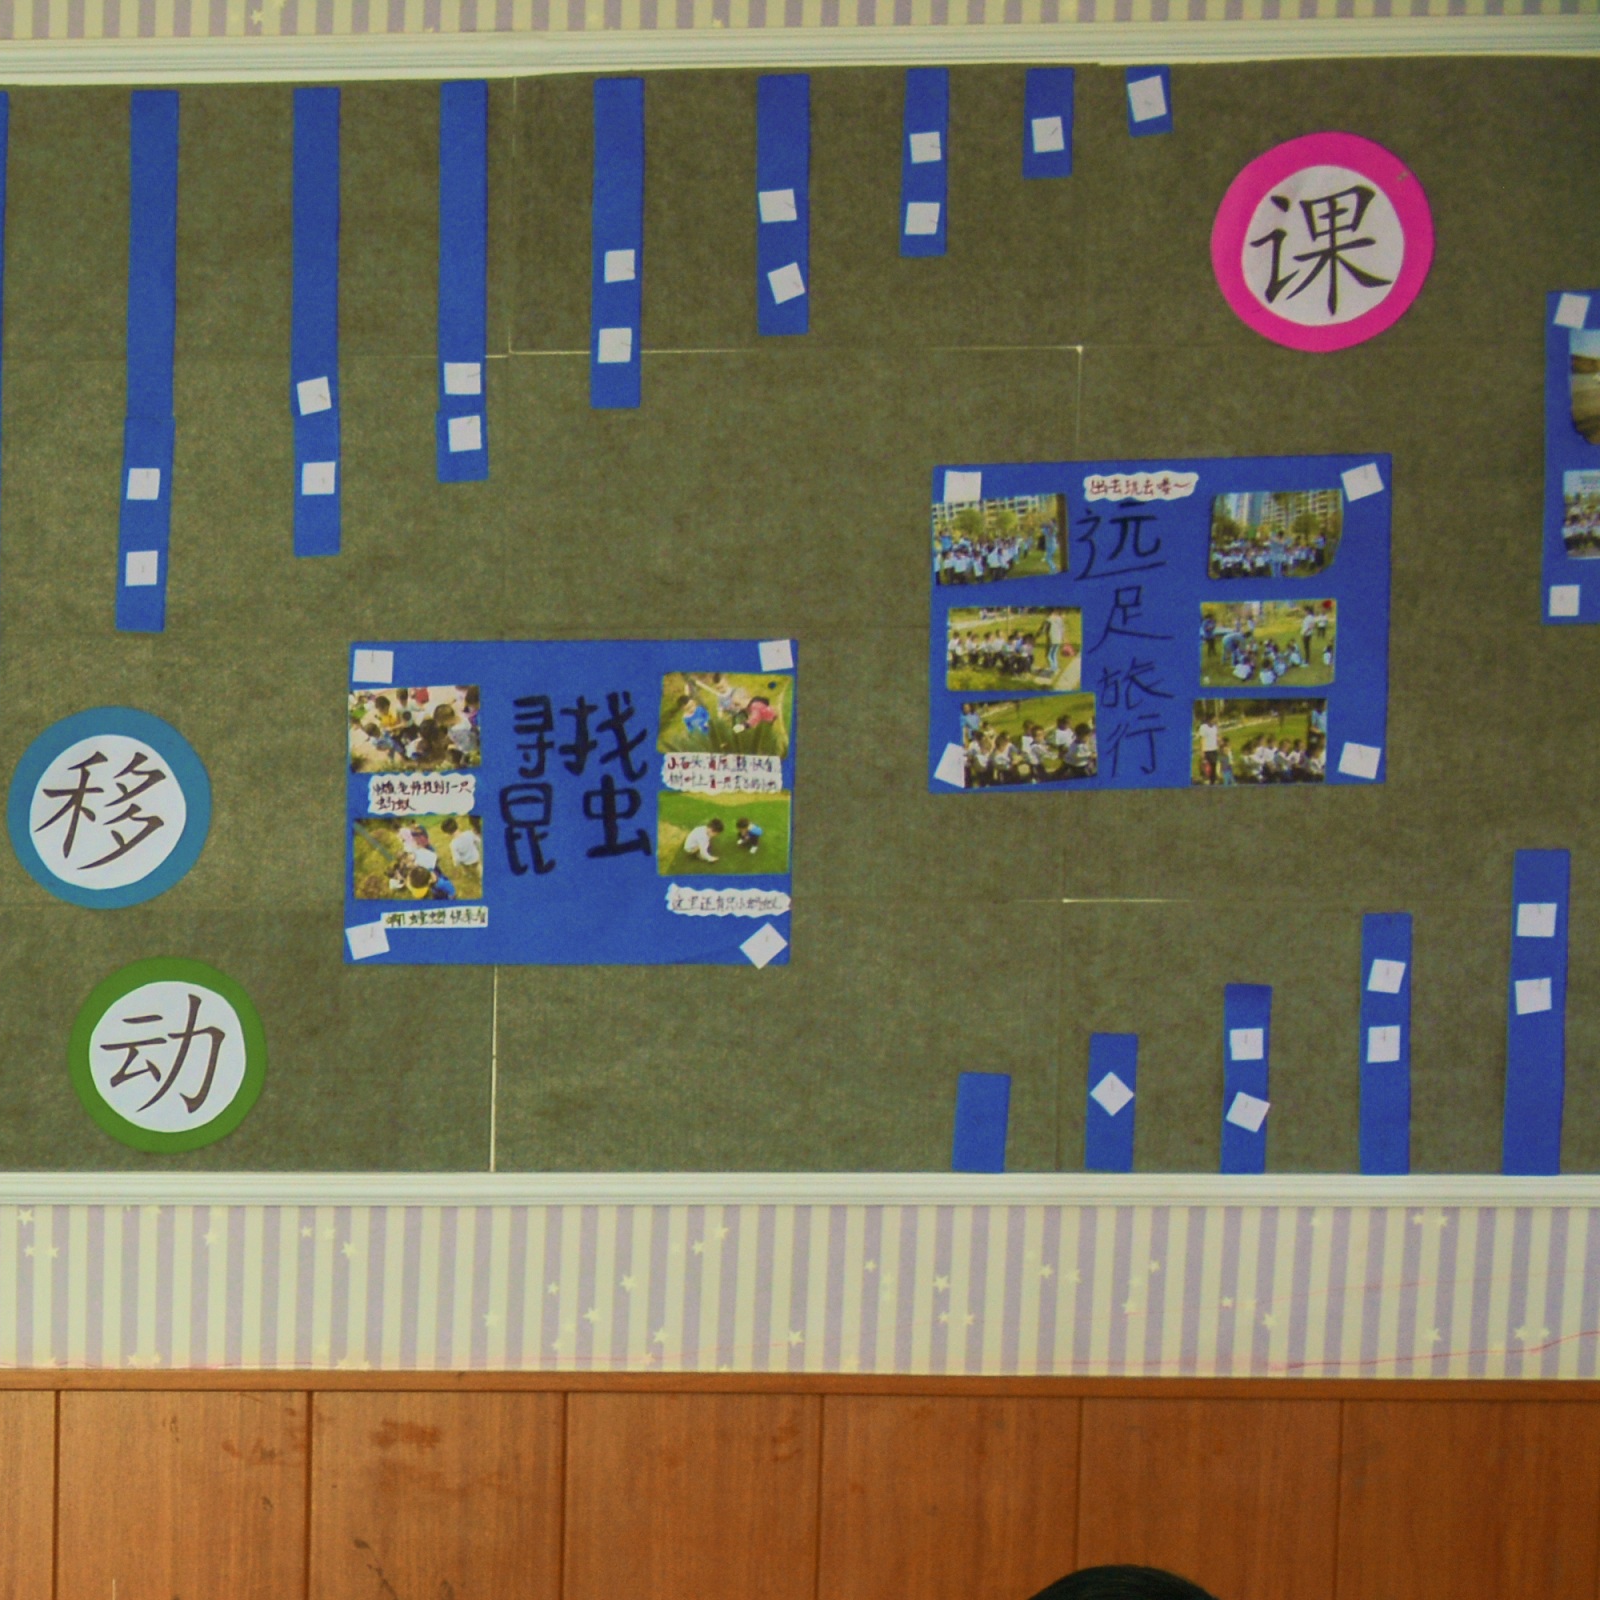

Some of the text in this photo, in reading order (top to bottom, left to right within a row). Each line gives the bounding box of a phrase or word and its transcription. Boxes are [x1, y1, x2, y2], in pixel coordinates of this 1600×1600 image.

[1249, 184, 1392, 316] 课
[1073, 501, 1175, 779] 远足旅行
[513, 691, 648, 782] 寻找
[34, 750, 166, 871] 移
[499, 774, 651, 876] 昆虫
[100, 994, 225, 1113] 动
